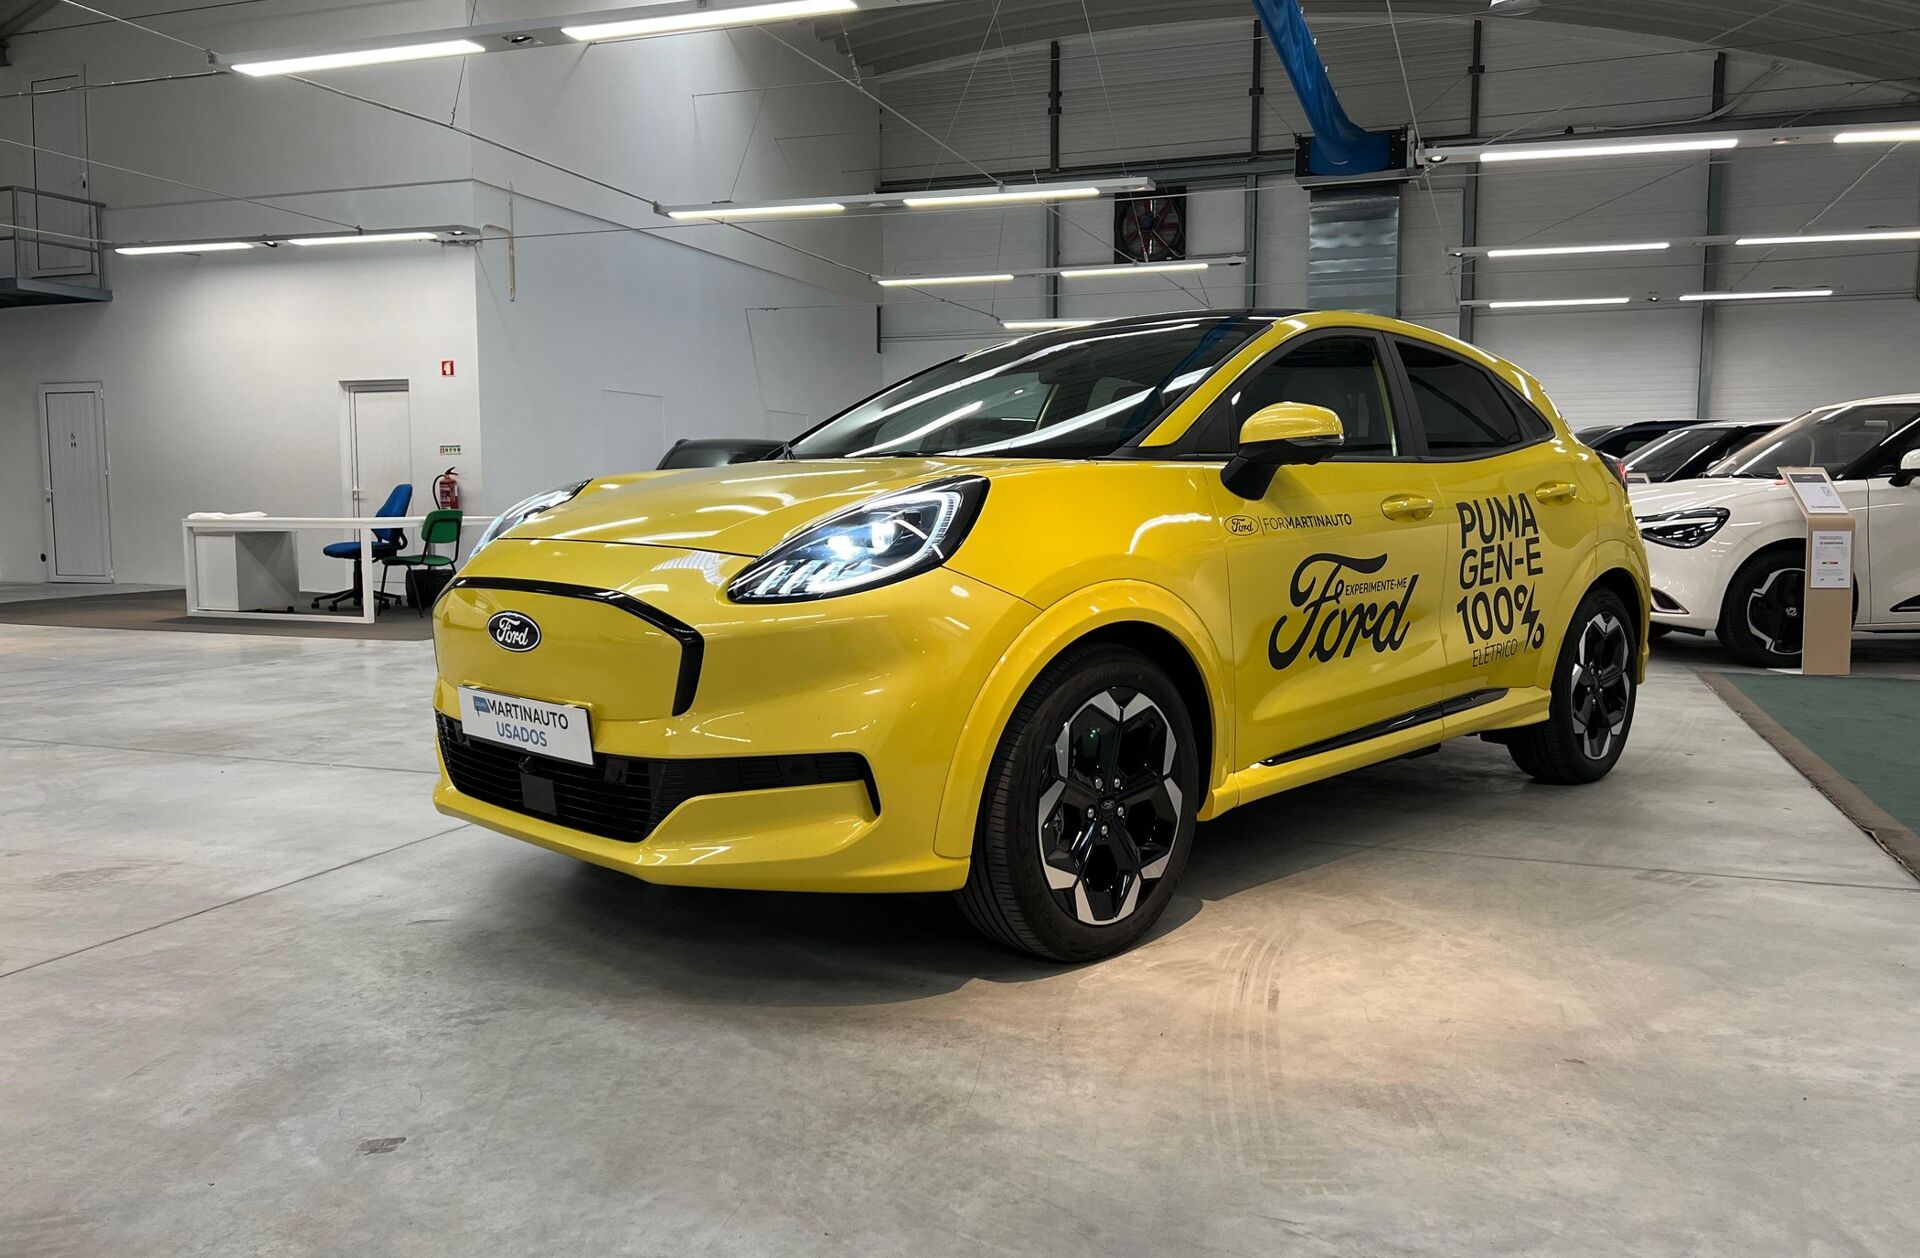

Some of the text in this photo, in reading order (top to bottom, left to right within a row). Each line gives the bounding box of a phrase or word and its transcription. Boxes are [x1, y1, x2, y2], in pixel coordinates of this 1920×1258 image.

[1231, 518, 1254, 533] Ford
[1456, 492, 1539, 548] PUMA
[1459, 537, 1544, 590] GEN-E
[1345, 577, 1408, 596] EXPERIMENTE-ME
[1268, 553, 1419, 671] Ford
[1456, 581, 1545, 654] 100%
[496, 617, 529, 646] Ford
[1472, 638, 1518, 668] ELÉTRICO
[487, 698, 569, 730] MARTINAUTO
[496, 721, 548, 747] USADOS
